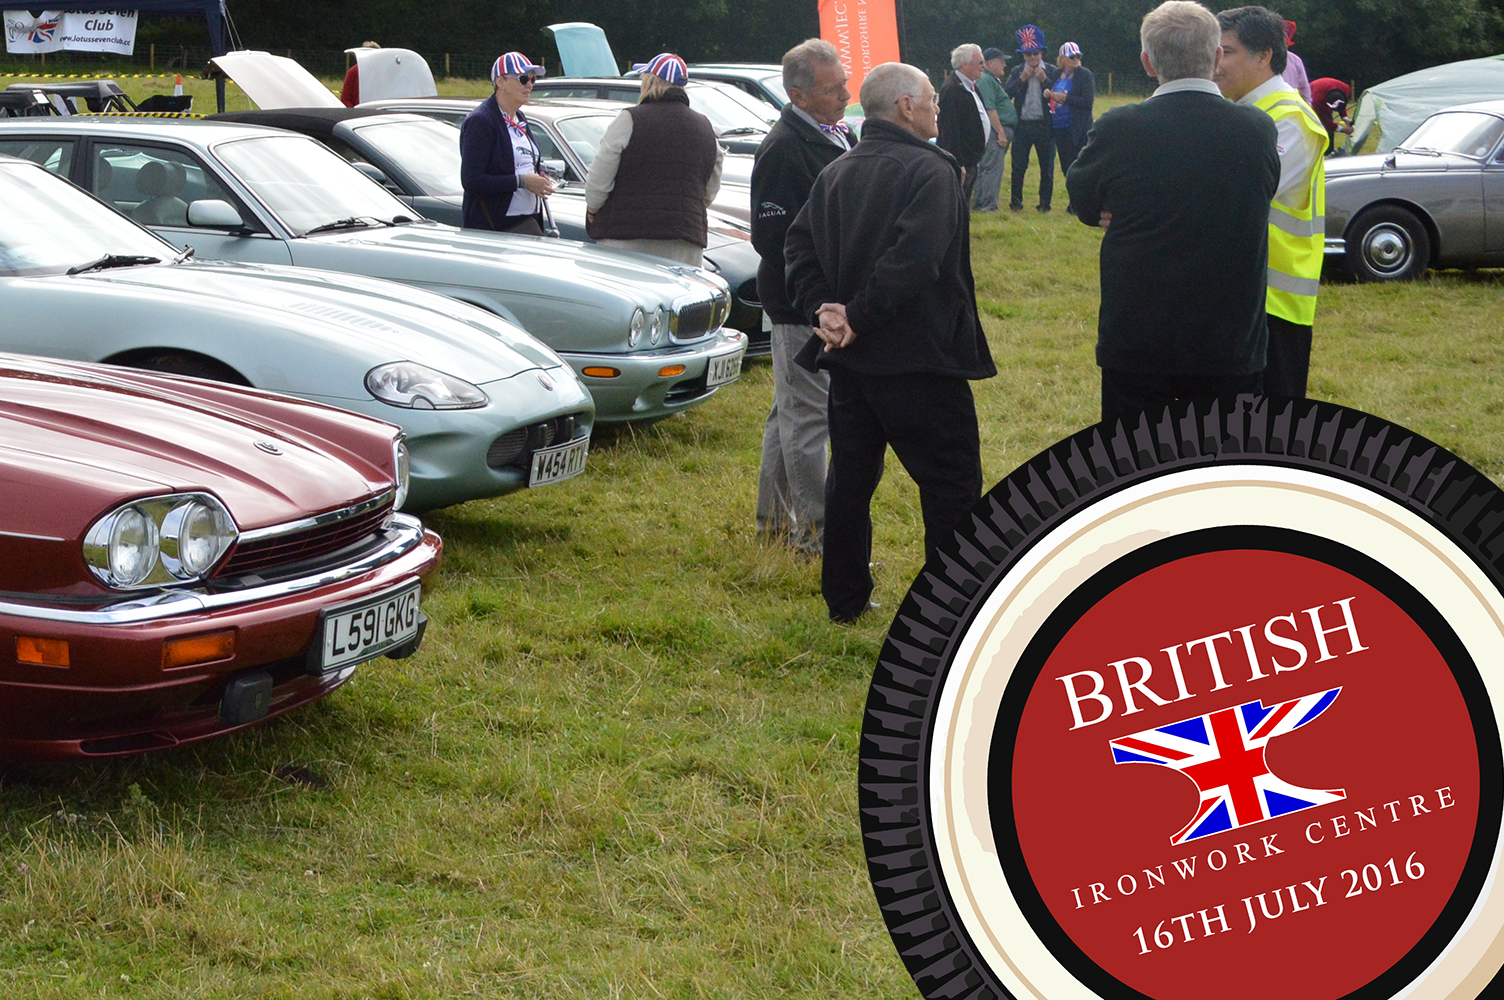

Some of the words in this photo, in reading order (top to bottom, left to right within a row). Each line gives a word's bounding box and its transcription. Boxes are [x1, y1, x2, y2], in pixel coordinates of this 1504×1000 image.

[85, 19, 114, 31] Club
[758, 209, 787, 219] JAGUAR
[537, 450, 567, 481] W454
[332, 606, 381, 657] L591
[384, 591, 415, 638] GKG
